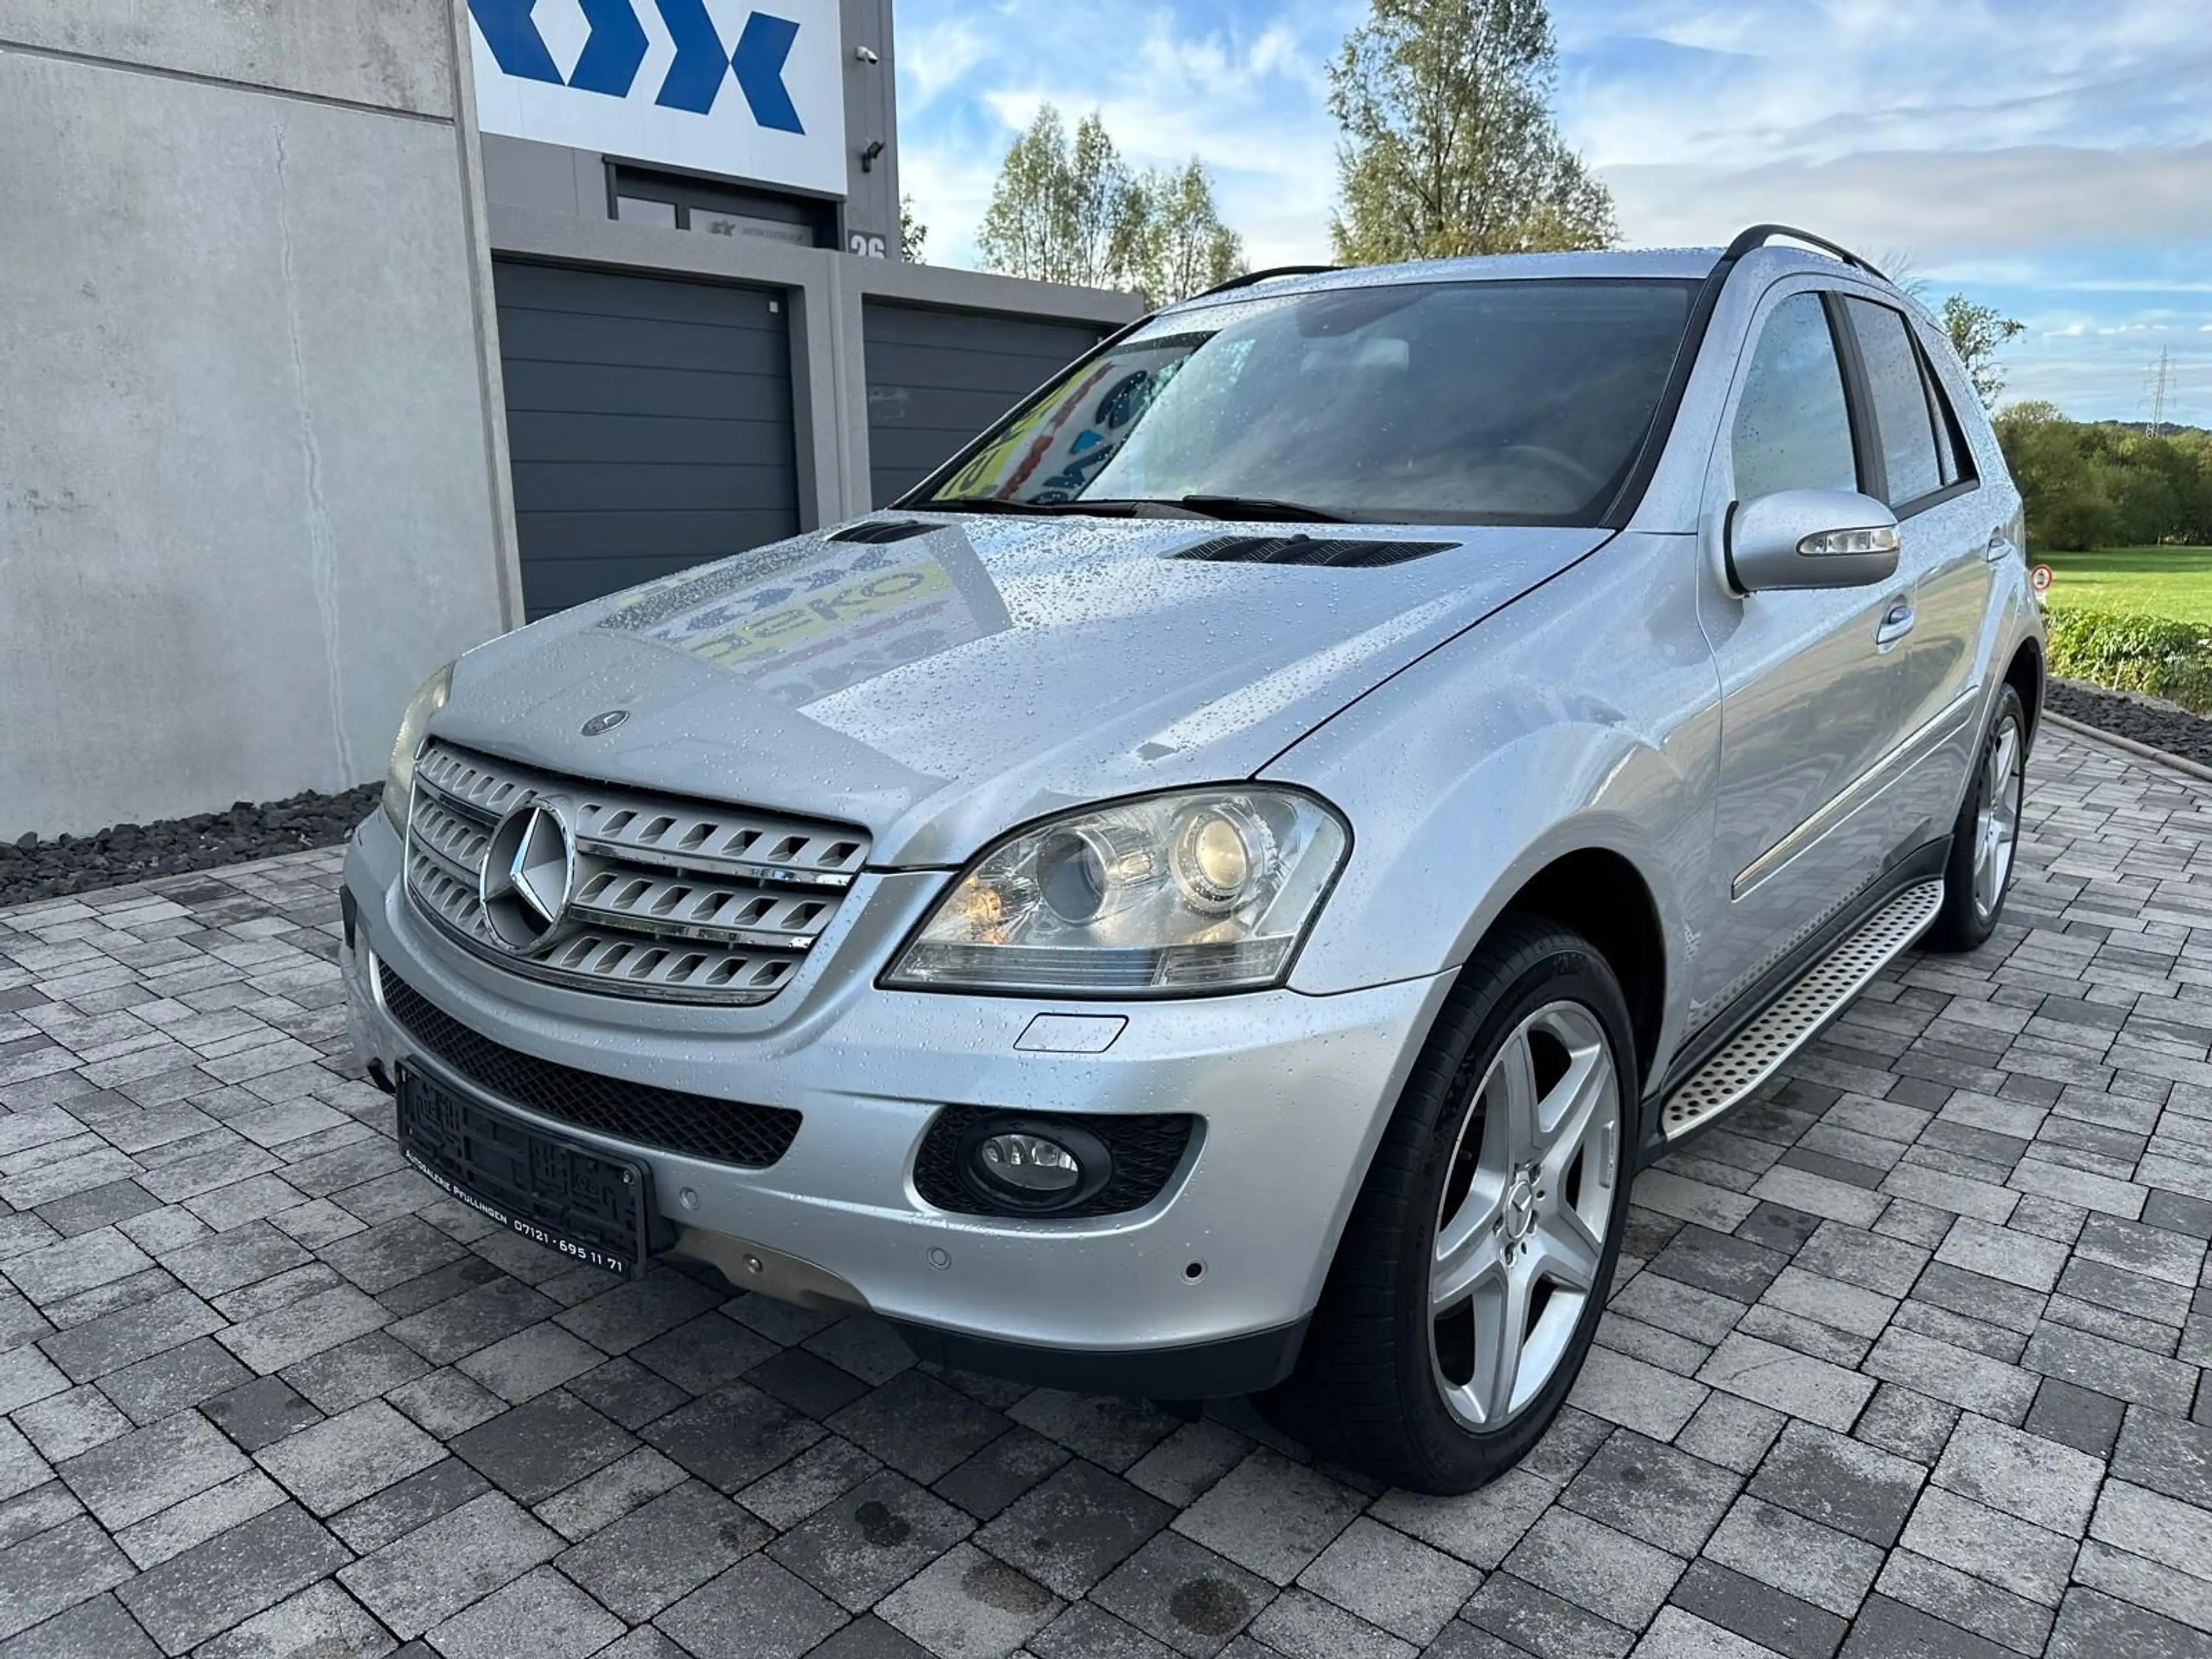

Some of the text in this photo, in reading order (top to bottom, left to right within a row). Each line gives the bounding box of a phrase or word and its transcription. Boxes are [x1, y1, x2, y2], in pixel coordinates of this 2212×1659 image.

[514, 1219, 548, 1244] 07121
[559, 1240, 587, 1259] 695
[590, 1252, 602, 1266] 11
[607, 1257, 622, 1272] 71
